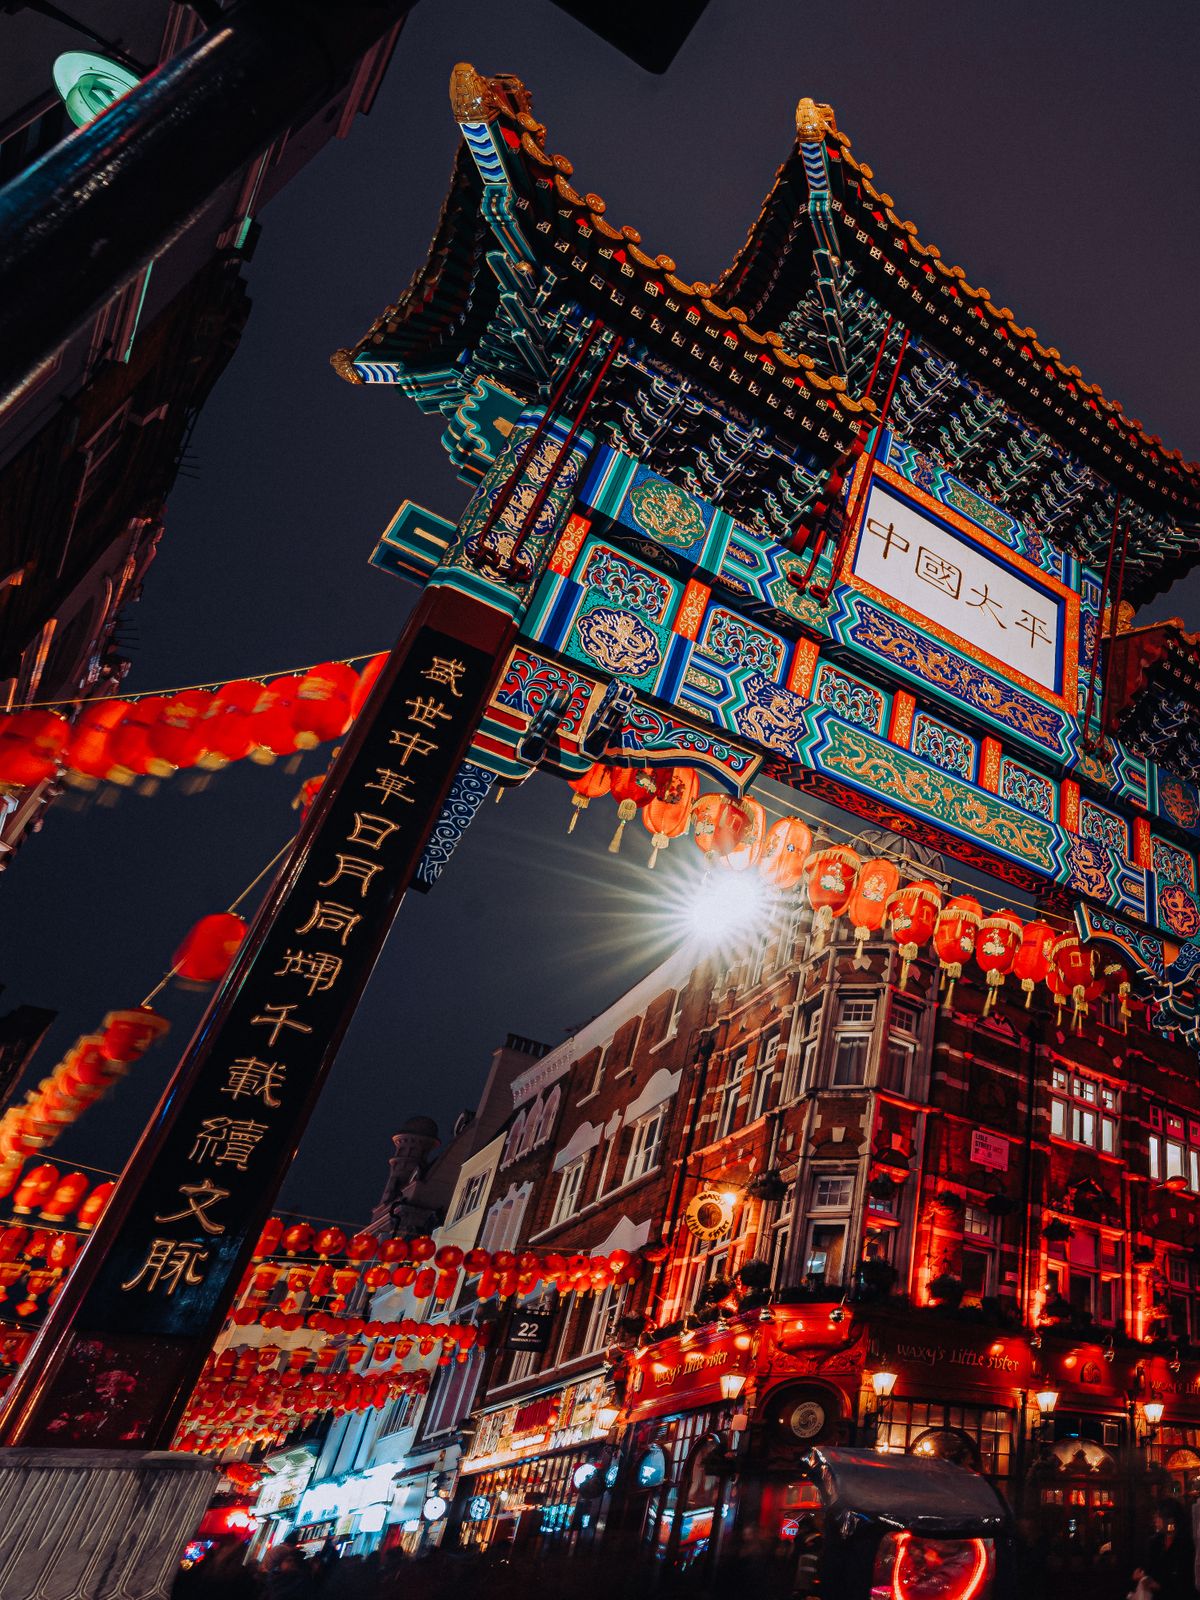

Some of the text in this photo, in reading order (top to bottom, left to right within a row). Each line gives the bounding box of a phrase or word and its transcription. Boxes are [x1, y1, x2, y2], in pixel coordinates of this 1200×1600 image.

[866, 517, 1053, 649] 中國太平
[517, 1322, 539, 1337] 22
